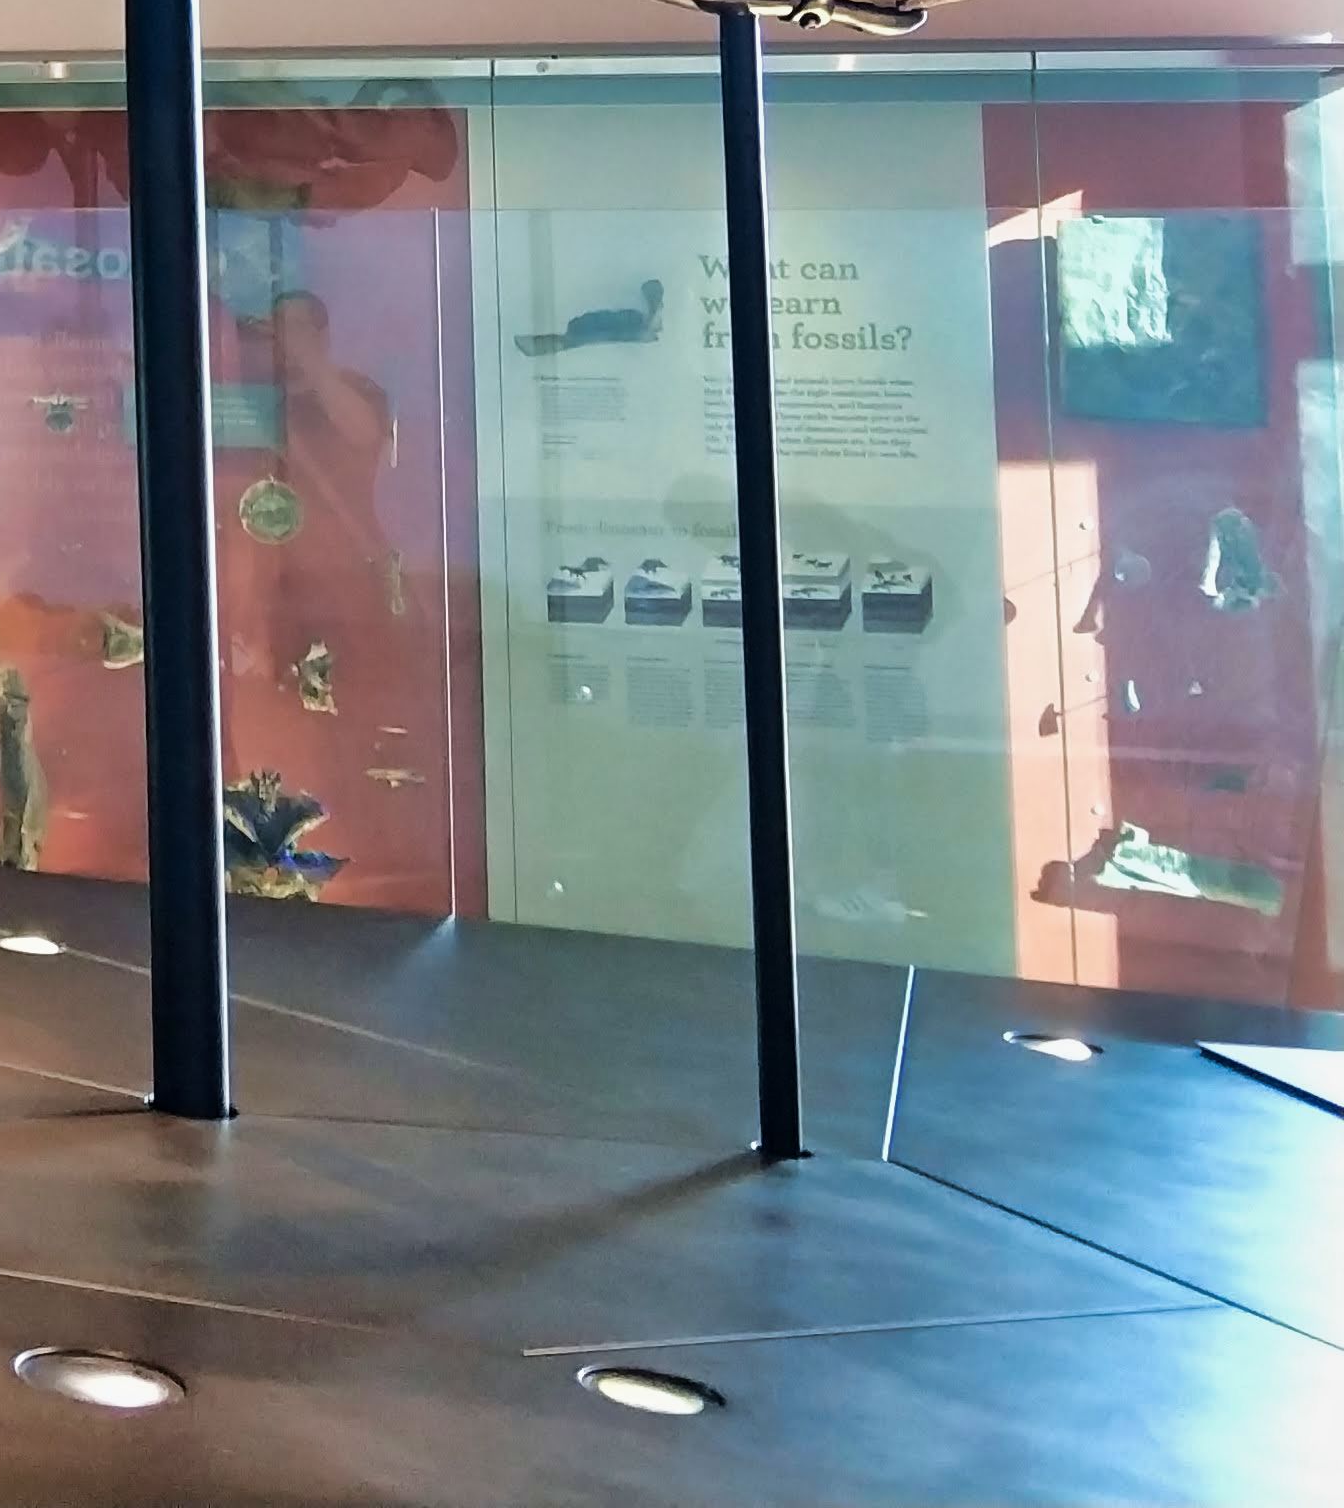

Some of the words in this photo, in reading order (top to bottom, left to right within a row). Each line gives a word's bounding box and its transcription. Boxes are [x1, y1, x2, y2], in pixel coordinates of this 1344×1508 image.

[699, 254, 791, 281] Wt
[800, 261, 860, 281] can
[770, 295, 842, 316] earn
[703, 322, 781, 349] fr
[792, 322, 913, 351] fossils?
